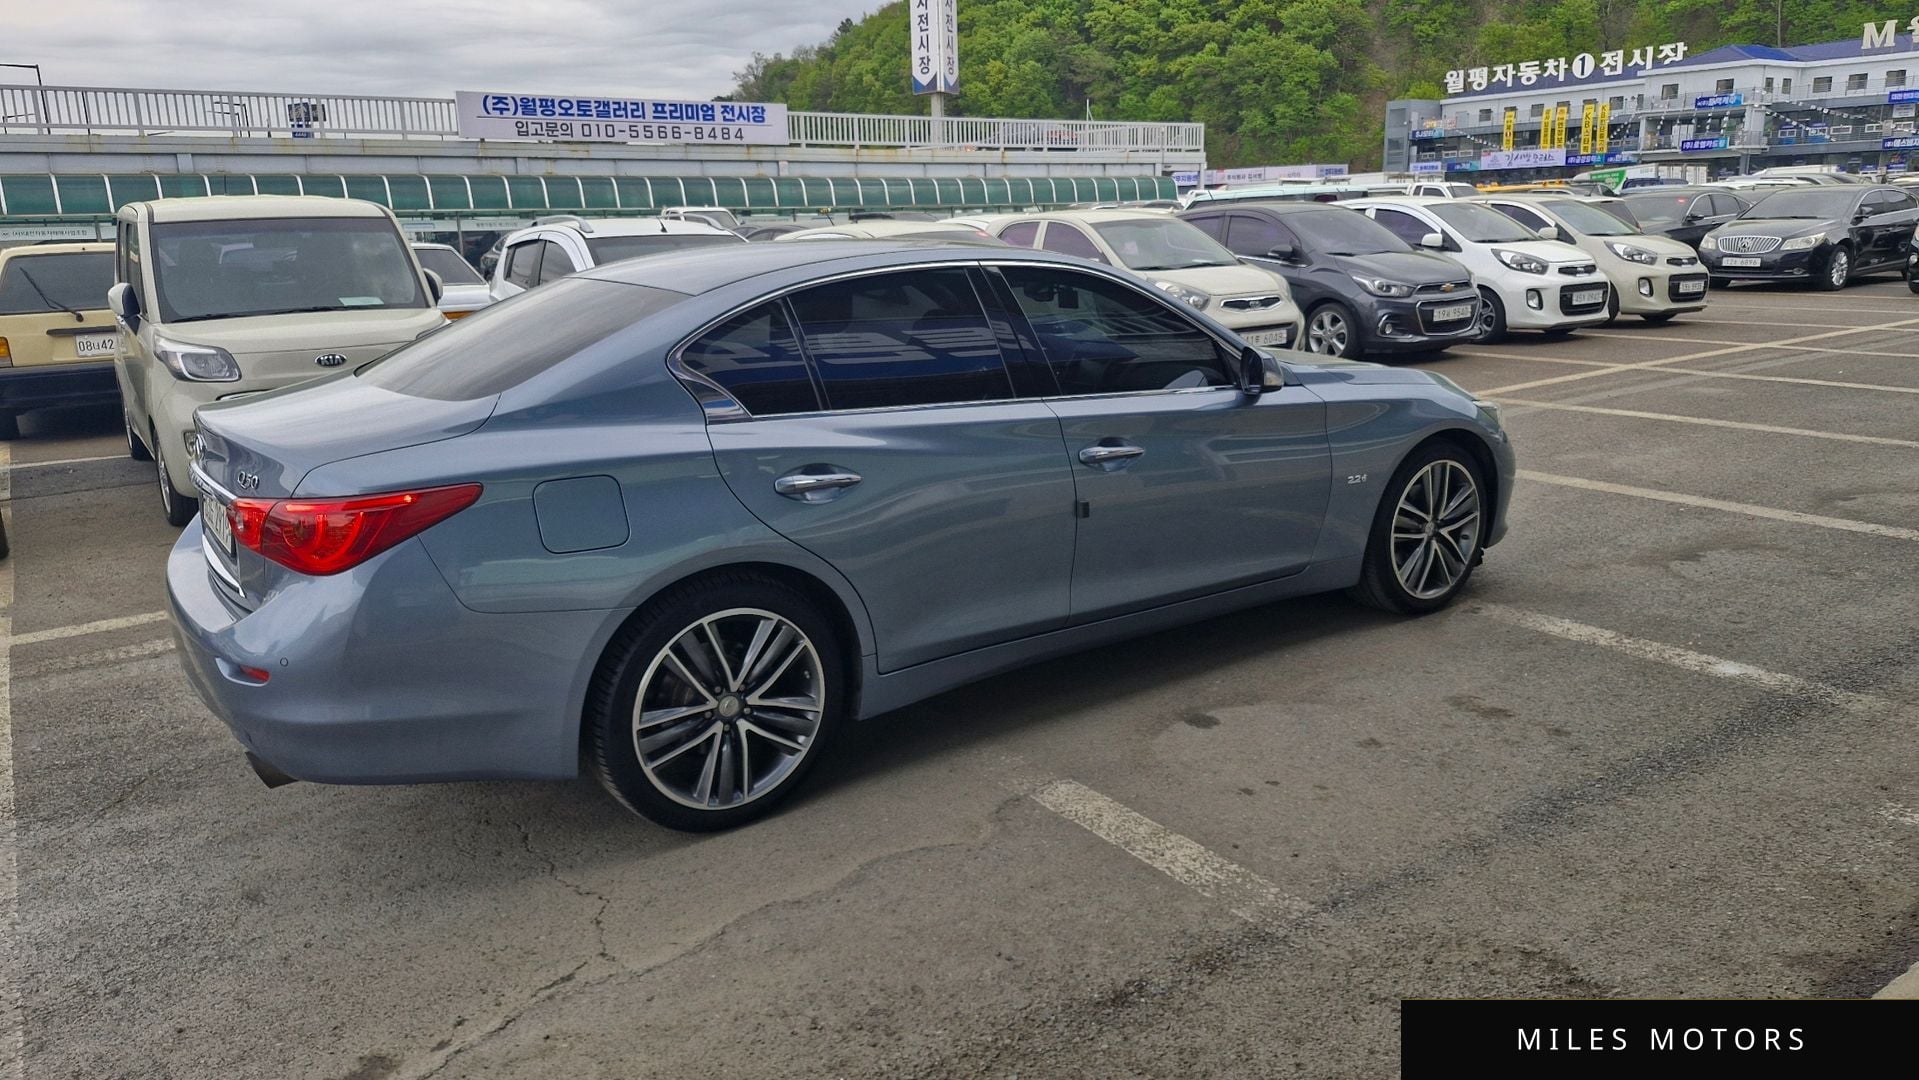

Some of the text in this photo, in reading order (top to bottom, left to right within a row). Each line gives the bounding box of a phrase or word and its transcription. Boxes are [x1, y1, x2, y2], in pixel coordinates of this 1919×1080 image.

[482, 95, 766, 123] (주)월평오토갤러리 프리미엄 전시장
[515, 121, 745, 141] 입고문의 010-5566-8484
[320, 355, 342, 366] KIA
[238, 471, 259, 490] Q50
